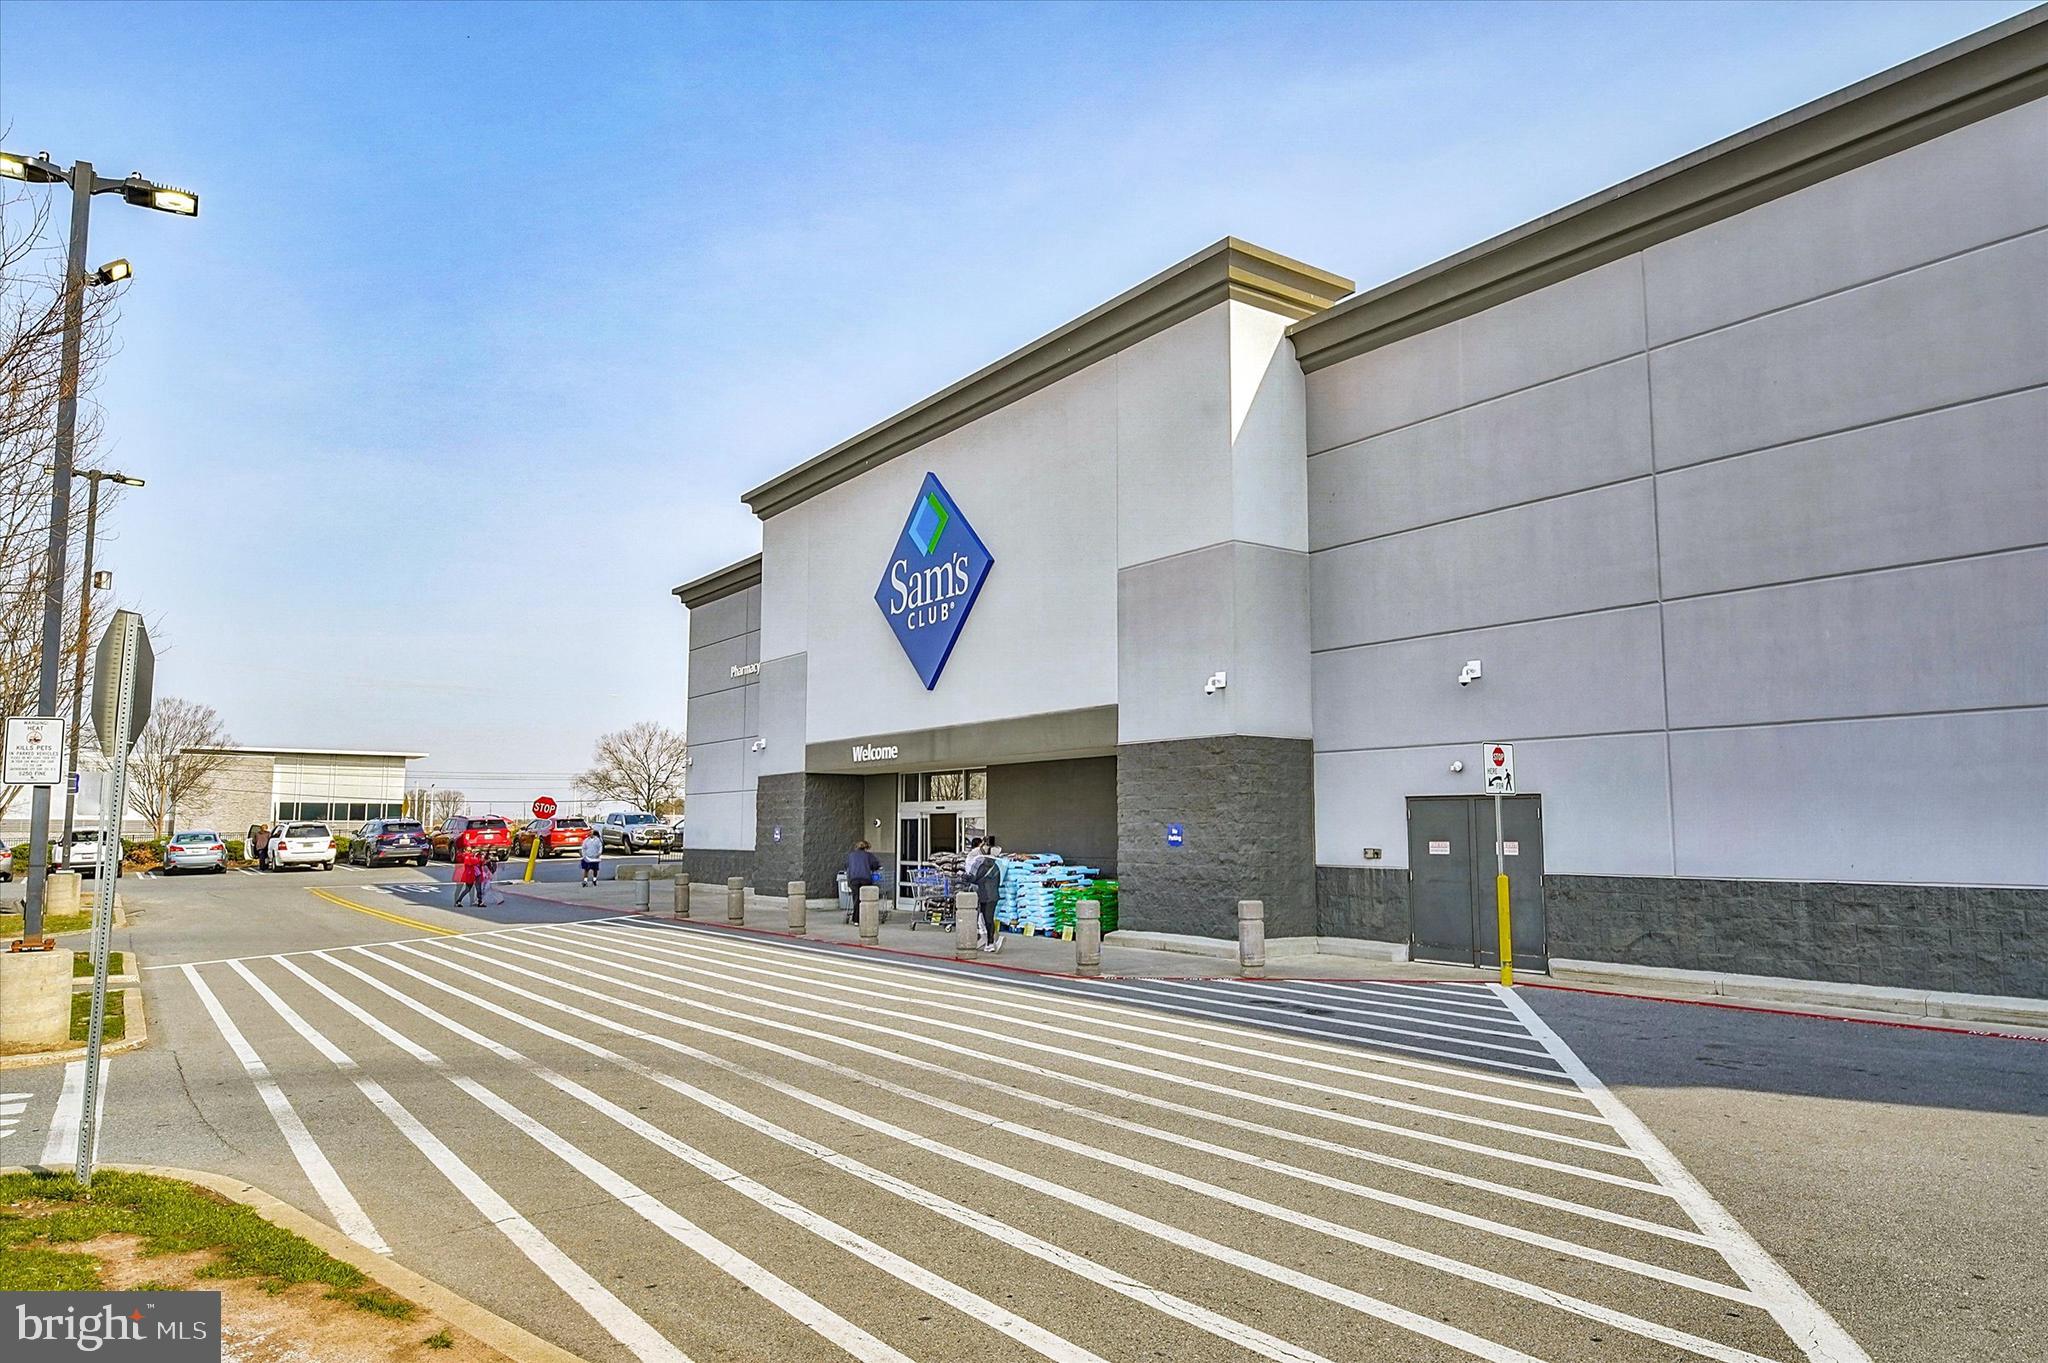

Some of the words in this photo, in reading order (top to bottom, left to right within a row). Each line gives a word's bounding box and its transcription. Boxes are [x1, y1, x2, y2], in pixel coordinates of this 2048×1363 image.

[890, 552, 970, 616] Sam's
[729, 661, 761, 679] Pharmacy
[852, 743, 899, 762] Welcome
[1492, 753, 1505, 761] STOP
[1487, 767, 1498, 775] HERE
[1496, 782, 1504, 790] FOR
[533, 802, 557, 814] STOP
